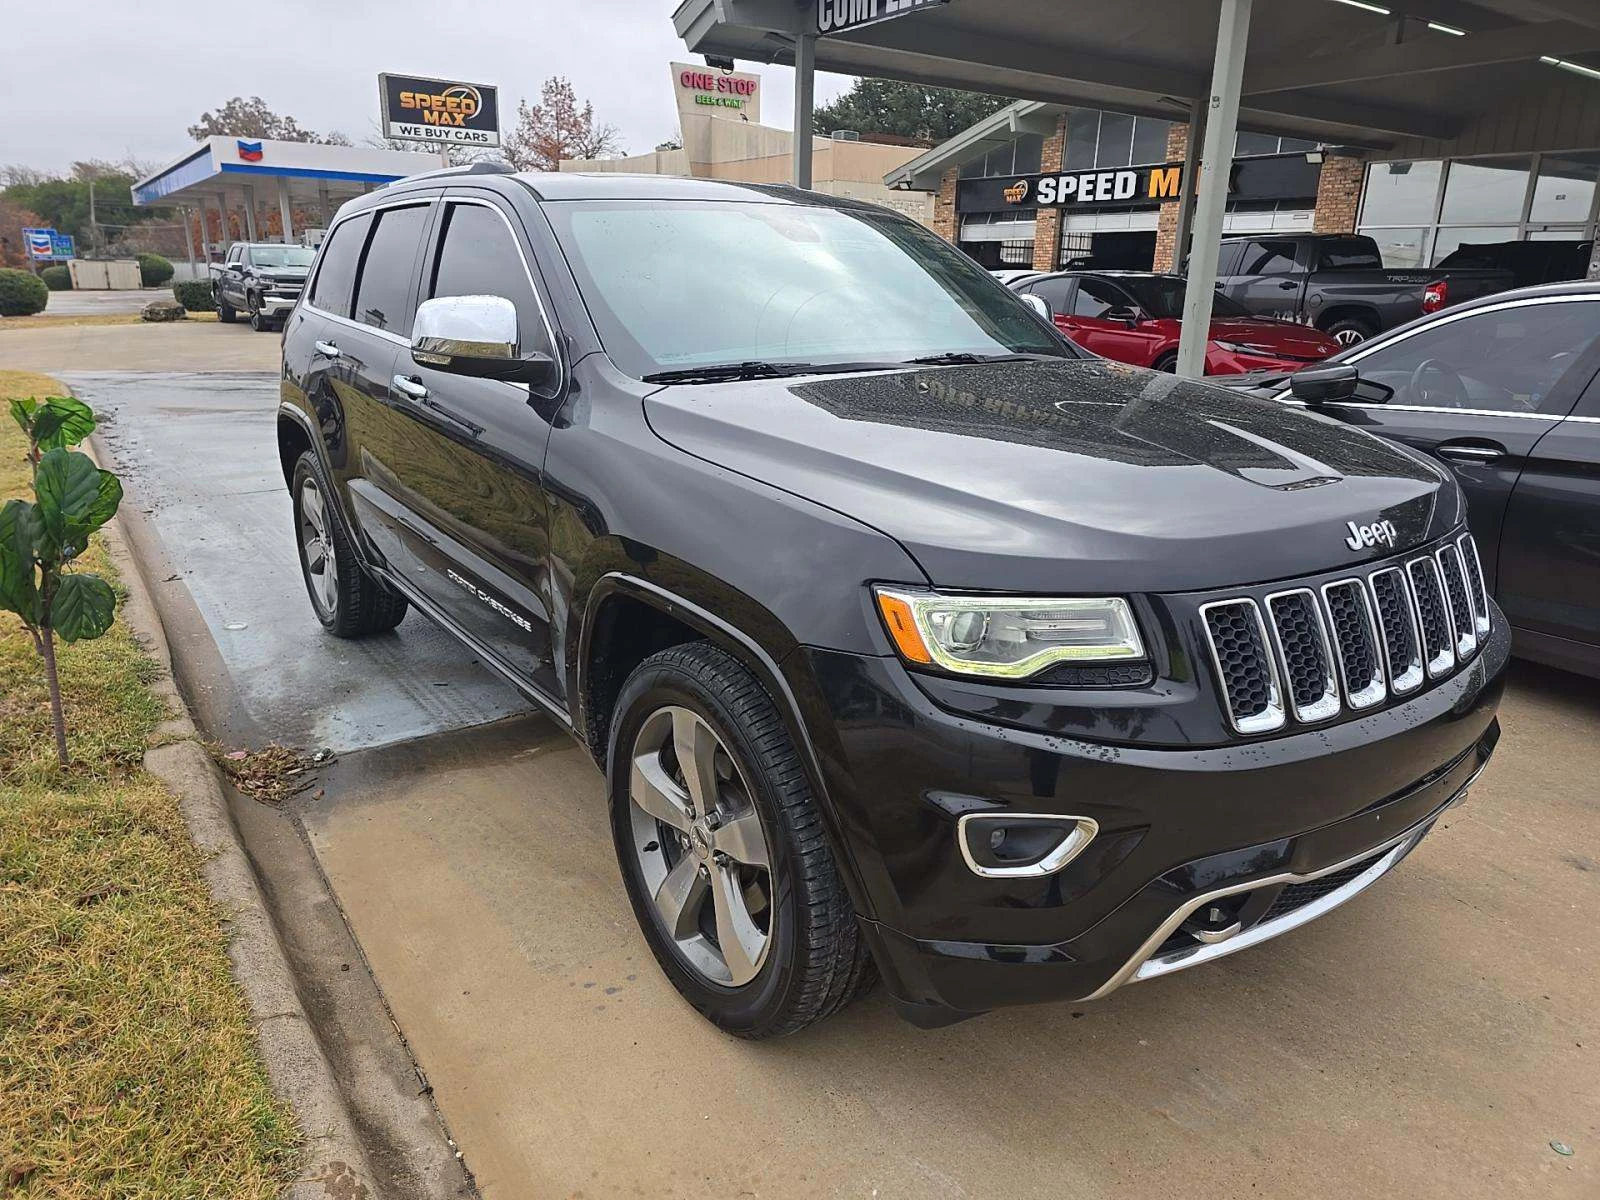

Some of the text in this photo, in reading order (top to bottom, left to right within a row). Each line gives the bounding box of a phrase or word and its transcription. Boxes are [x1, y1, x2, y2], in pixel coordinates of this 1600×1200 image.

[681, 71, 757, 96] ONE STOP
[399, 91, 476, 115] SPEED
[423, 109, 466, 127] MAX
[400, 125, 489, 142] WE BUY CARS
[1037, 171, 1137, 204] SPEED
[1344, 520, 1397, 550] Jeep
